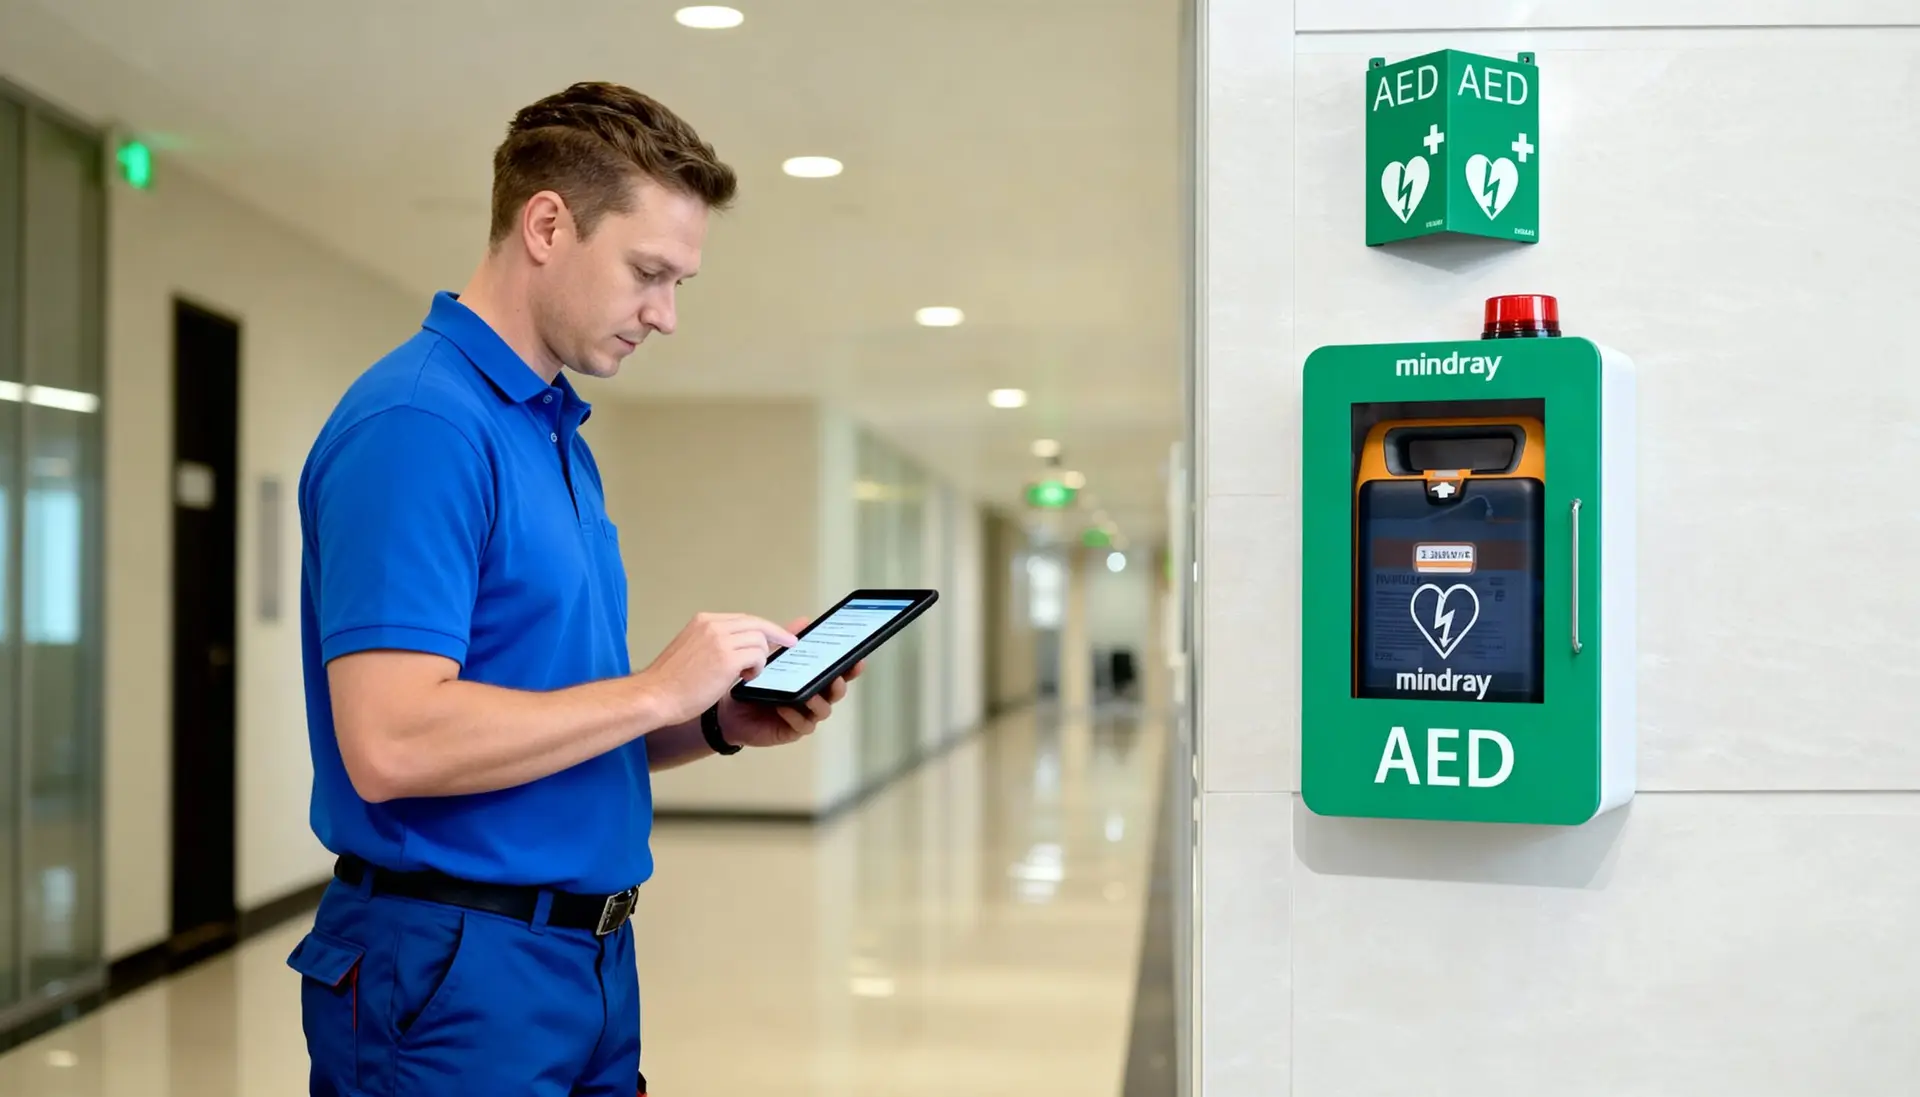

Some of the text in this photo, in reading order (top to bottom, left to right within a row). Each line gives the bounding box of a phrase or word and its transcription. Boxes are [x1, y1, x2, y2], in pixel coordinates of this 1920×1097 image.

[1373, 65, 1439, 112] AED
[1457, 64, 1528, 105] AED
[1396, 351, 1502, 381] mindray
[1396, 667, 1492, 700] mindray
[1374, 726, 1515, 788] AED
